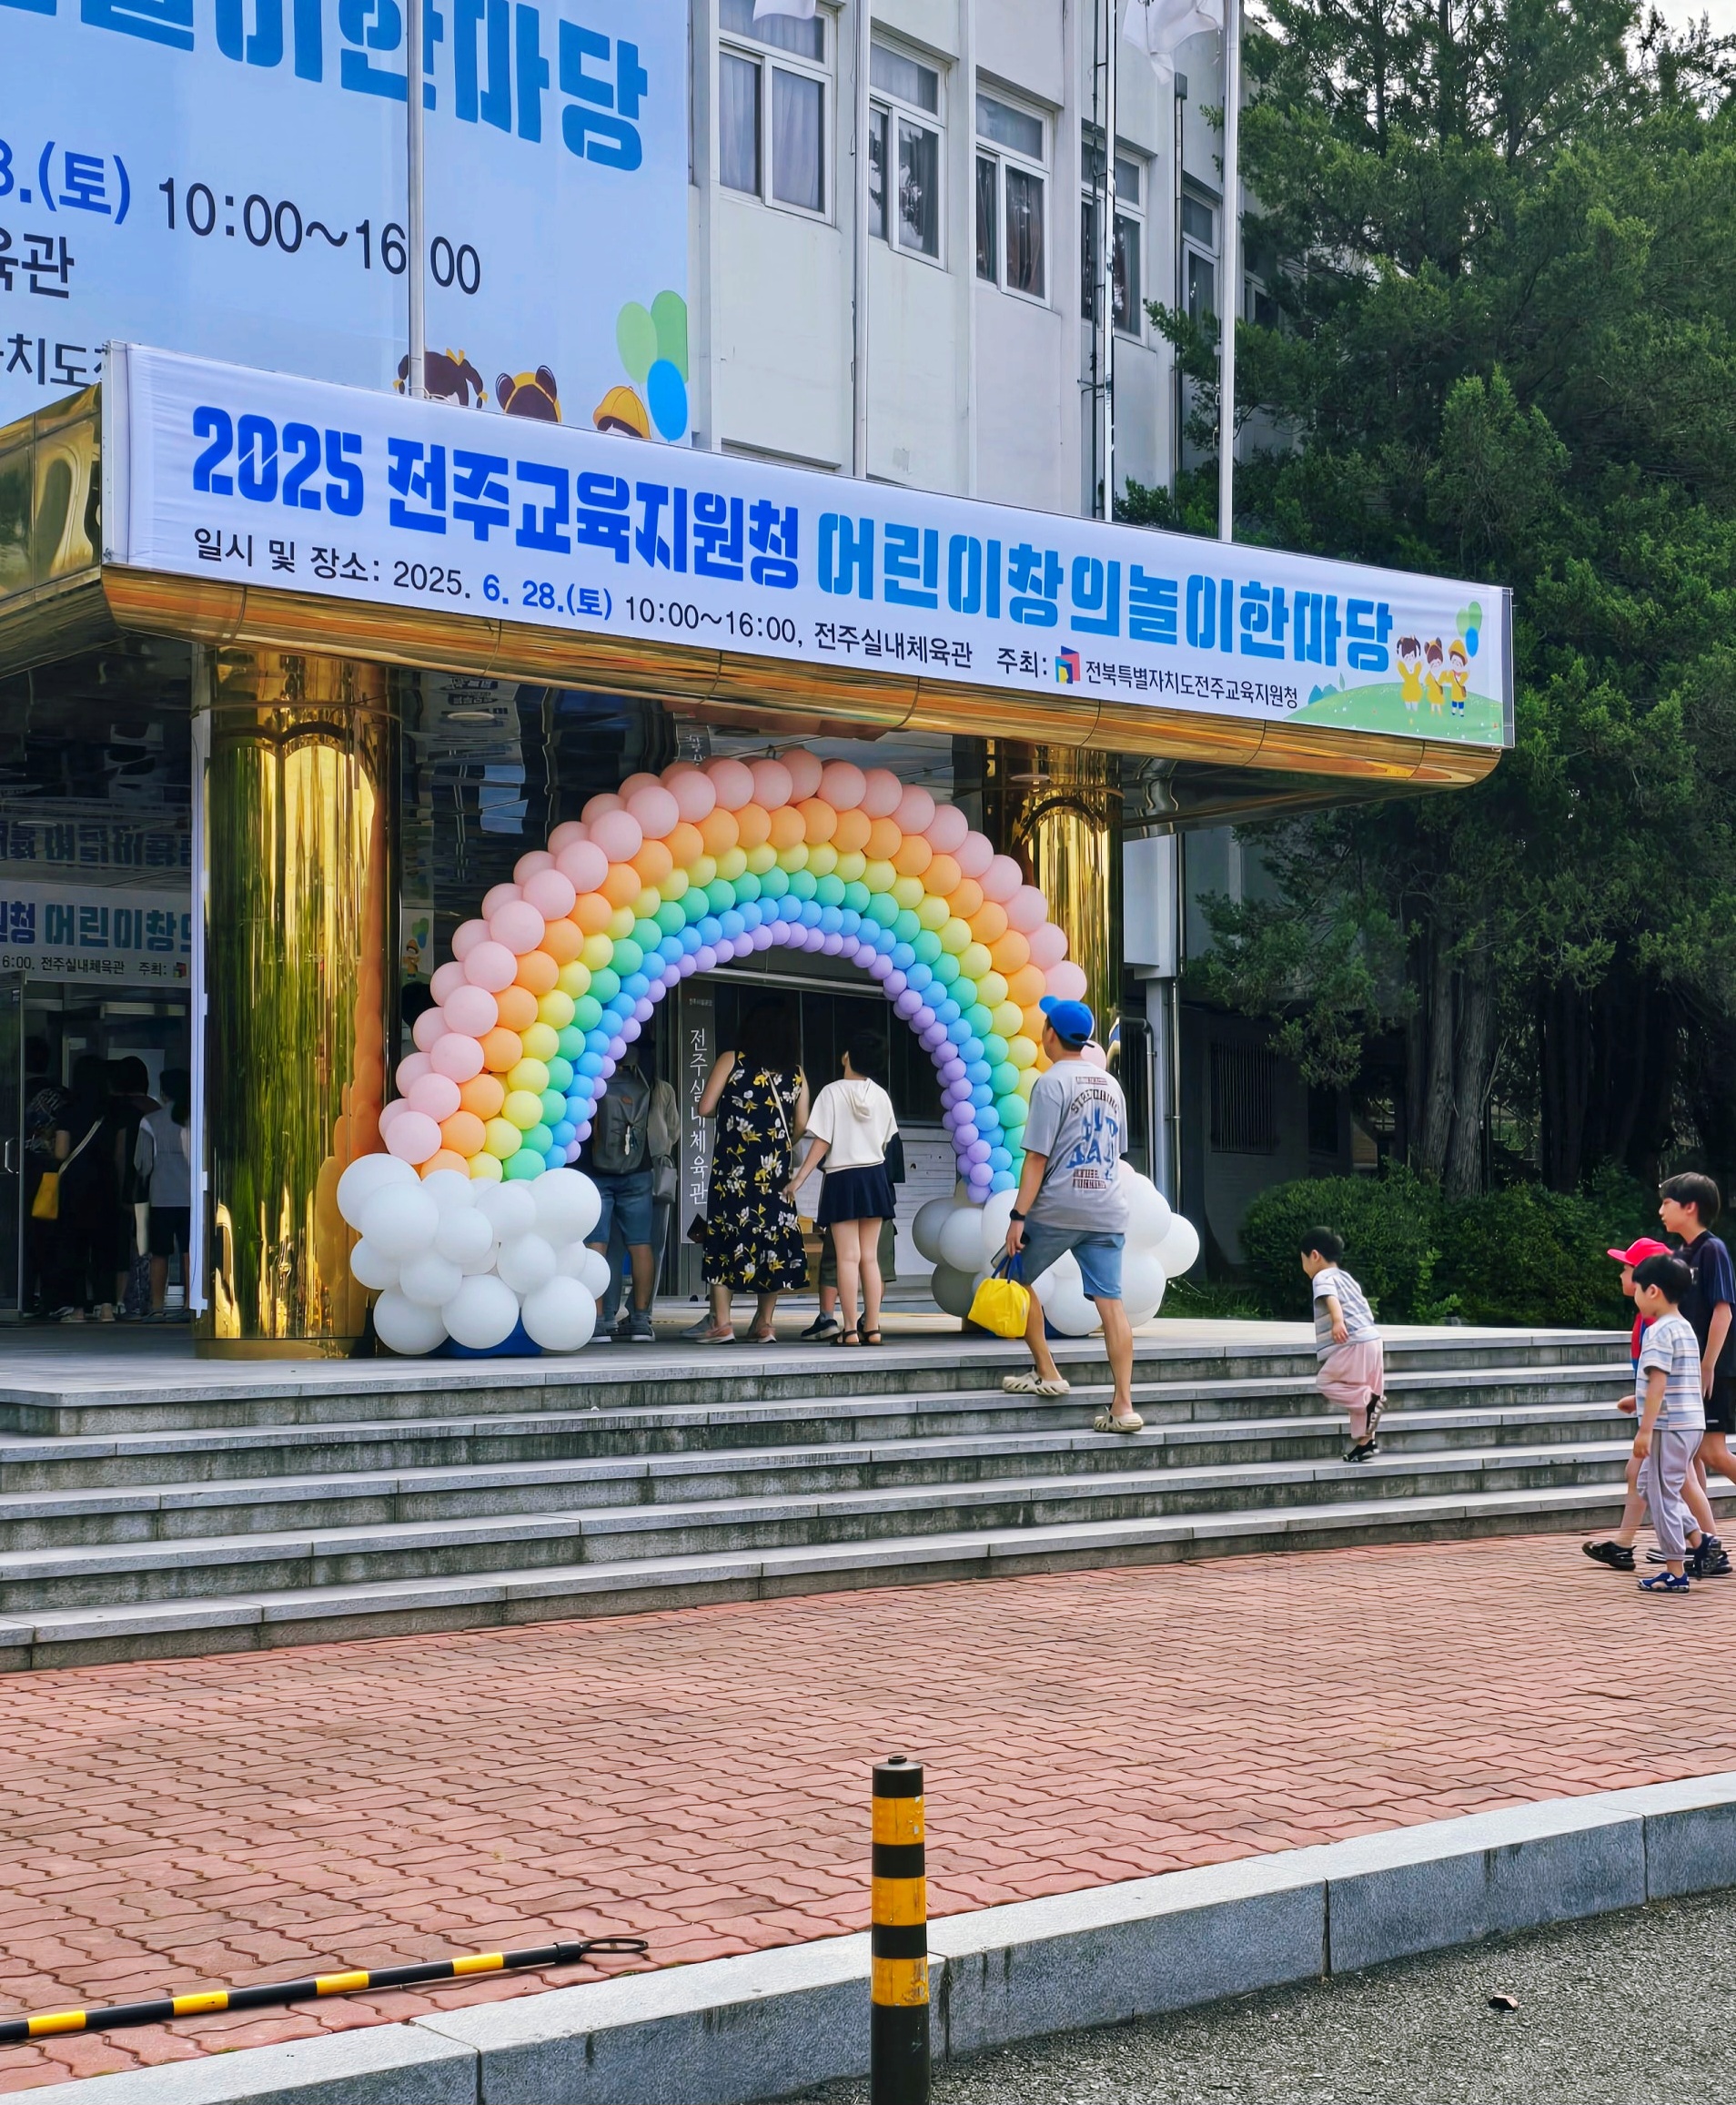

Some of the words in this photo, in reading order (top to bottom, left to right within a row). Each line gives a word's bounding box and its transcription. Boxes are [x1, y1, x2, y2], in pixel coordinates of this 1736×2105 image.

[192, 406, 364, 517] 2025
[388, 437, 801, 590] 전주교육지원청
[818, 512, 1393, 673] 어린이창의놀이한마당
[194, 528, 254, 567] 일시
[268, 539, 296, 573] 및
[310, 546, 379, 583] 장소:
[393, 560, 470, 599] 2025.
[482, 573, 510, 605] 6.
[521, 579, 612, 621] 28.(토)
[626, 595, 802, 648] 10:00~16:00,
[813, 622, 974, 669] 전주실내체육관
[996, 647, 1047, 679] 주최:
[1085, 660, 1298, 710] 전북특별자치도전주교육지원청
[41, 956, 125, 974] 전주실내체육관
